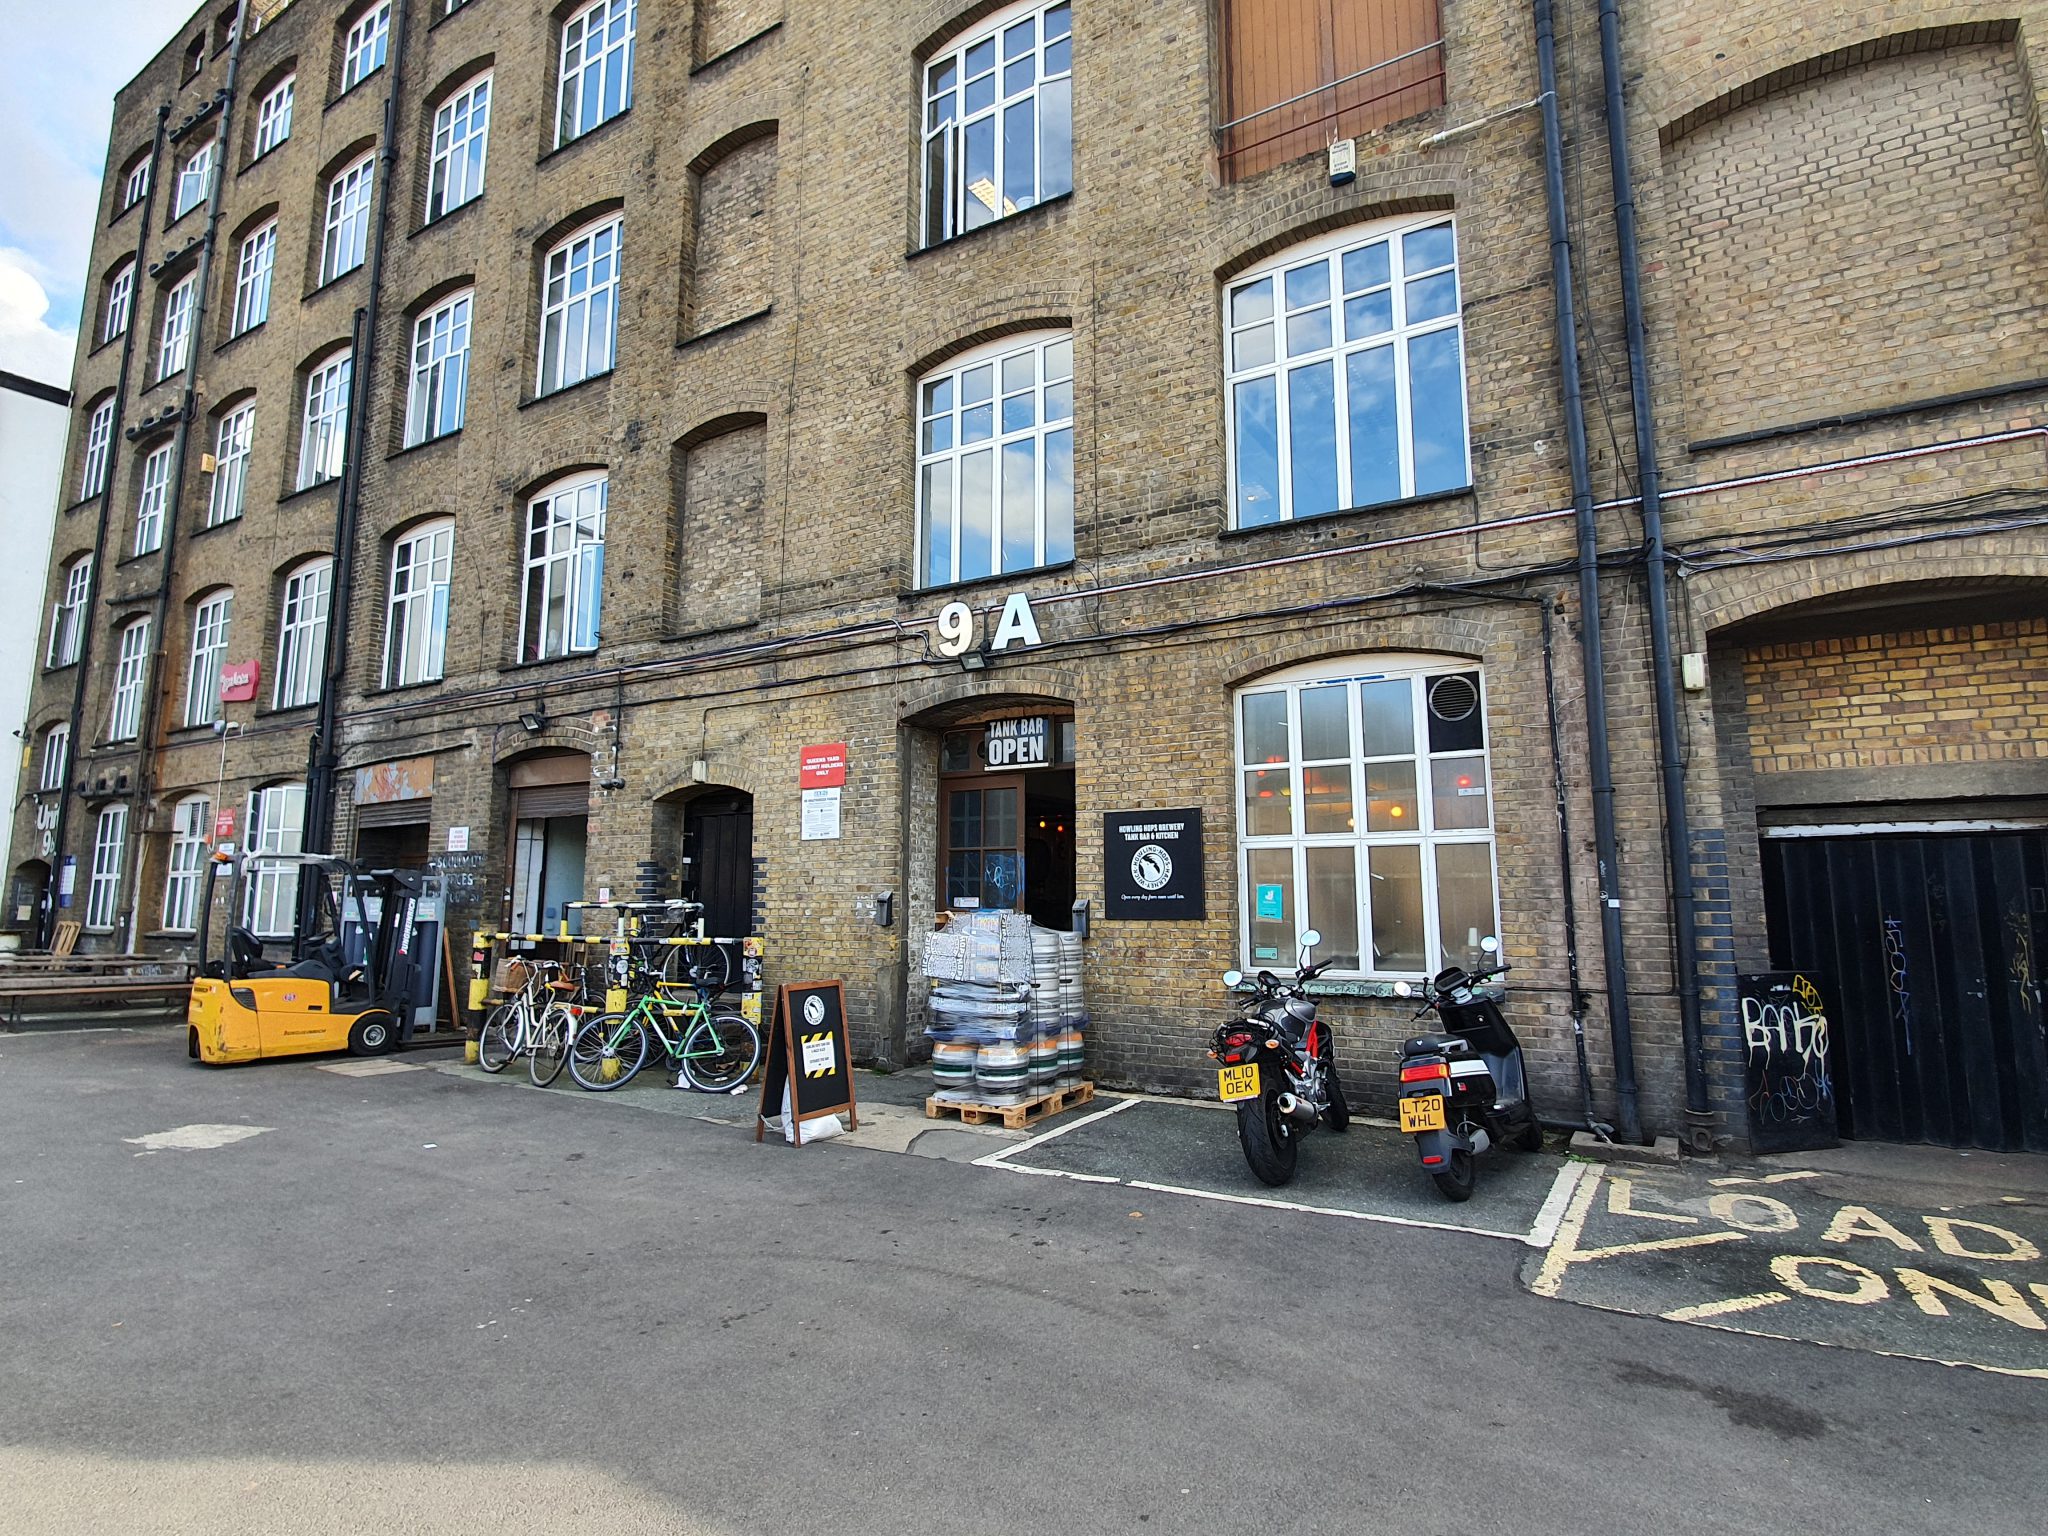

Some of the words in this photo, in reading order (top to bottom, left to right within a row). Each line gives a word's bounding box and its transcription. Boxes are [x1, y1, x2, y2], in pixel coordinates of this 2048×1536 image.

[989, 719, 1018, 738] TANK
[1020, 717, 1043, 736] BAR
[988, 735, 1044, 765] OPEN
[1119, 825, 1143, 833] HOWLING
[1143, 824, 1158, 832] HOPS
[1158, 823, 1185, 832] BREWERY
[1124, 833, 1139, 841] TANK
[1139, 833, 1150, 841] BAR
[1155, 831, 1179, 840] KITCHEN
[1133, 846, 1157, 867] HOWLING
[1158, 849, 1171, 866] HOPS
[399, 897, 417, 955] JUNGHEINRICH
[1223, 1066, 1254, 1082] ML10
[1226, 1079, 1253, 1095] OEK
[1402, 1098, 1441, 1115] LT20
[1408, 1113, 1437, 1128] WHL
[1769, 1254, 2048, 1331] ON
